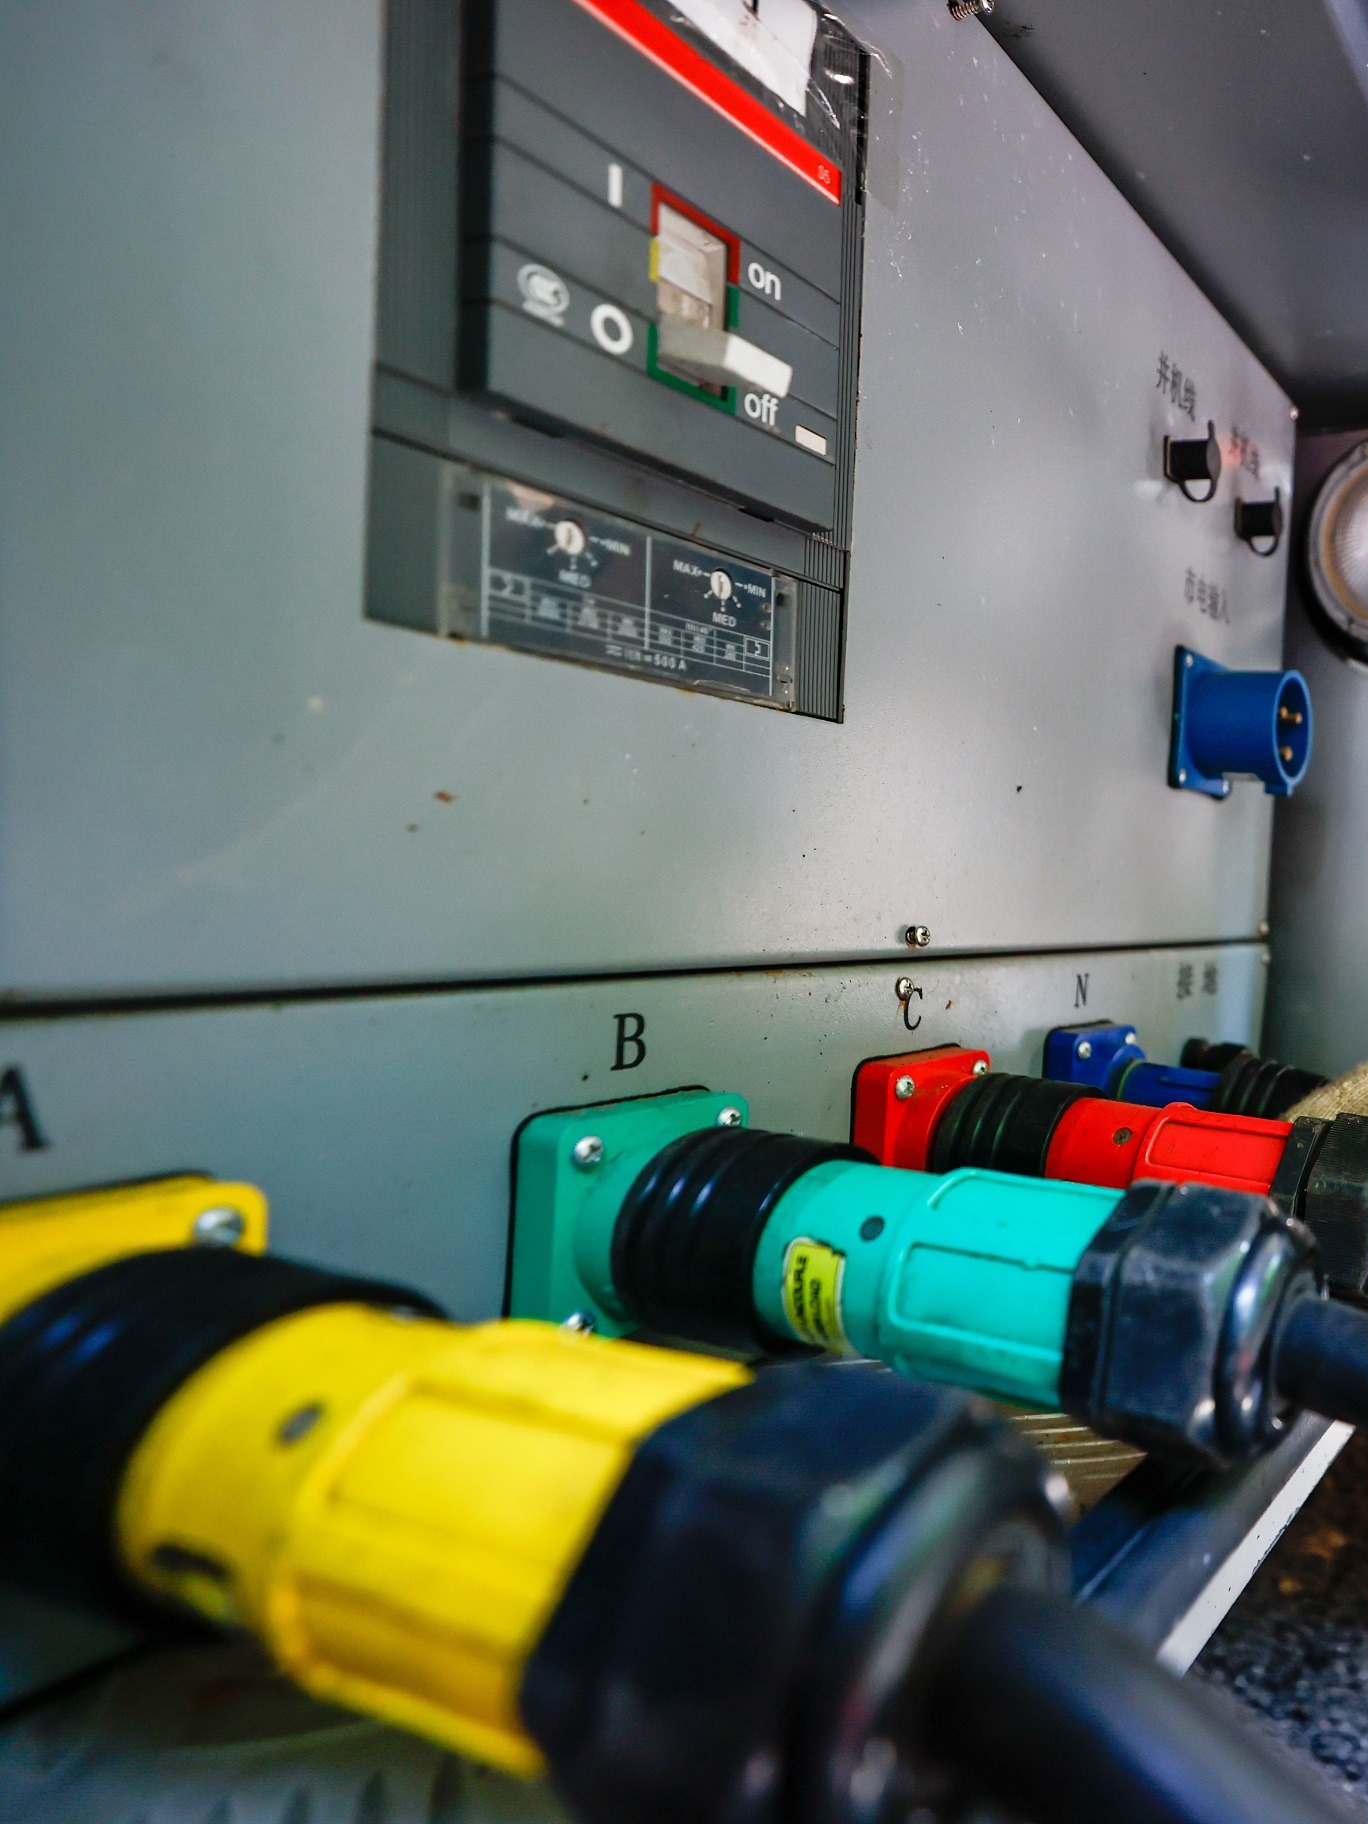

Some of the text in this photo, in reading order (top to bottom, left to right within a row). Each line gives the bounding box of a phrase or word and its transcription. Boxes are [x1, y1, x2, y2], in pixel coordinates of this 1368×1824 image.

[747, 261, 782, 300] on
[744, 392, 779, 426] off
[747, 583, 766, 599] MIN
[712, 612, 737, 628] MED
[903, 987, 923, 1031] C
[1073, 972, 1090, 1009] N
[610, 1012, 647, 1071] B
[0, 1063, 49, 1152] A
